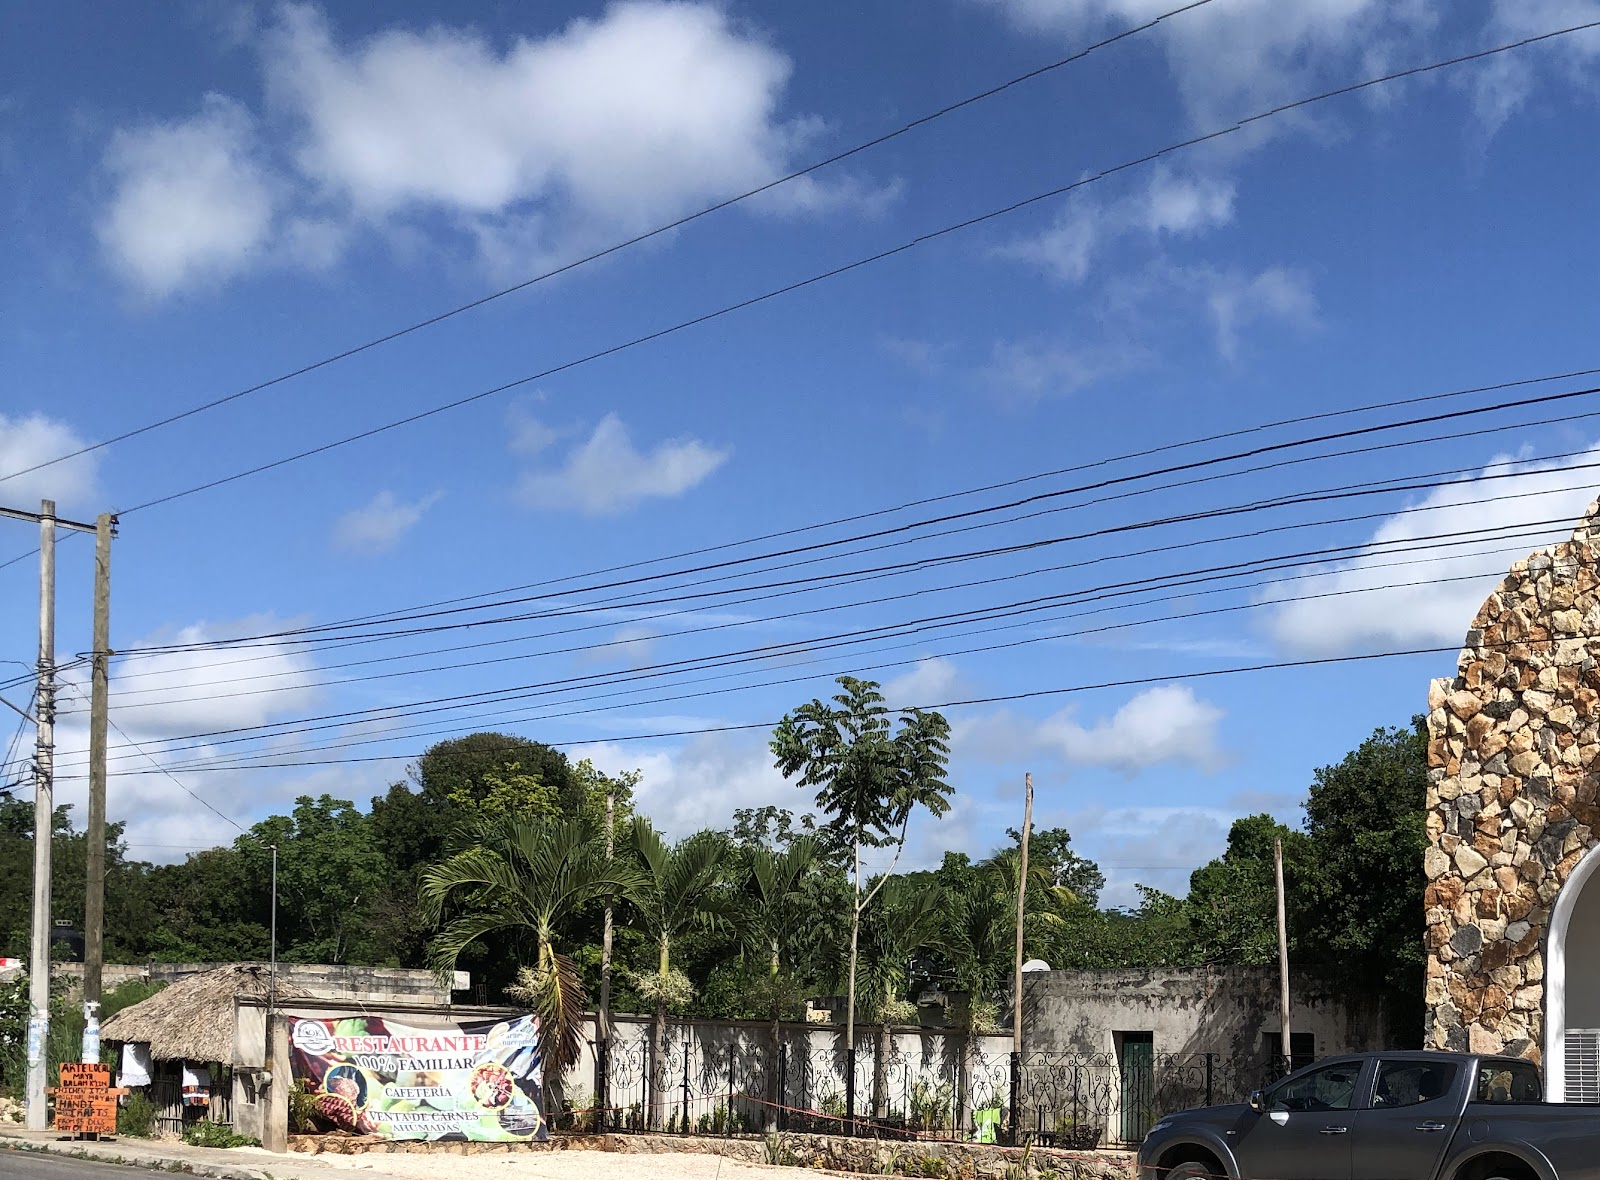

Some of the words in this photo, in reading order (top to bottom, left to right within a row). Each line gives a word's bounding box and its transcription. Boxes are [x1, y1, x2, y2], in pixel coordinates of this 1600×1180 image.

[335, 1036, 487, 1053] RESTAURANTE
[61, 1063, 87, 1073] ARTE
[88, 1063, 110, 1073] LOCAL
[355, 1056, 396, 1071] 100%
[399, 1058, 475, 1070] FAMILIAR
[385, 1086, 452, 1097] CAFETERÍA
[369, 1111, 409, 1122] VENTA
[411, 1112, 429, 1122] DE
[431, 1111, 479, 1122] CARNES
[393, 1123, 460, 1132] AHUMADAS
